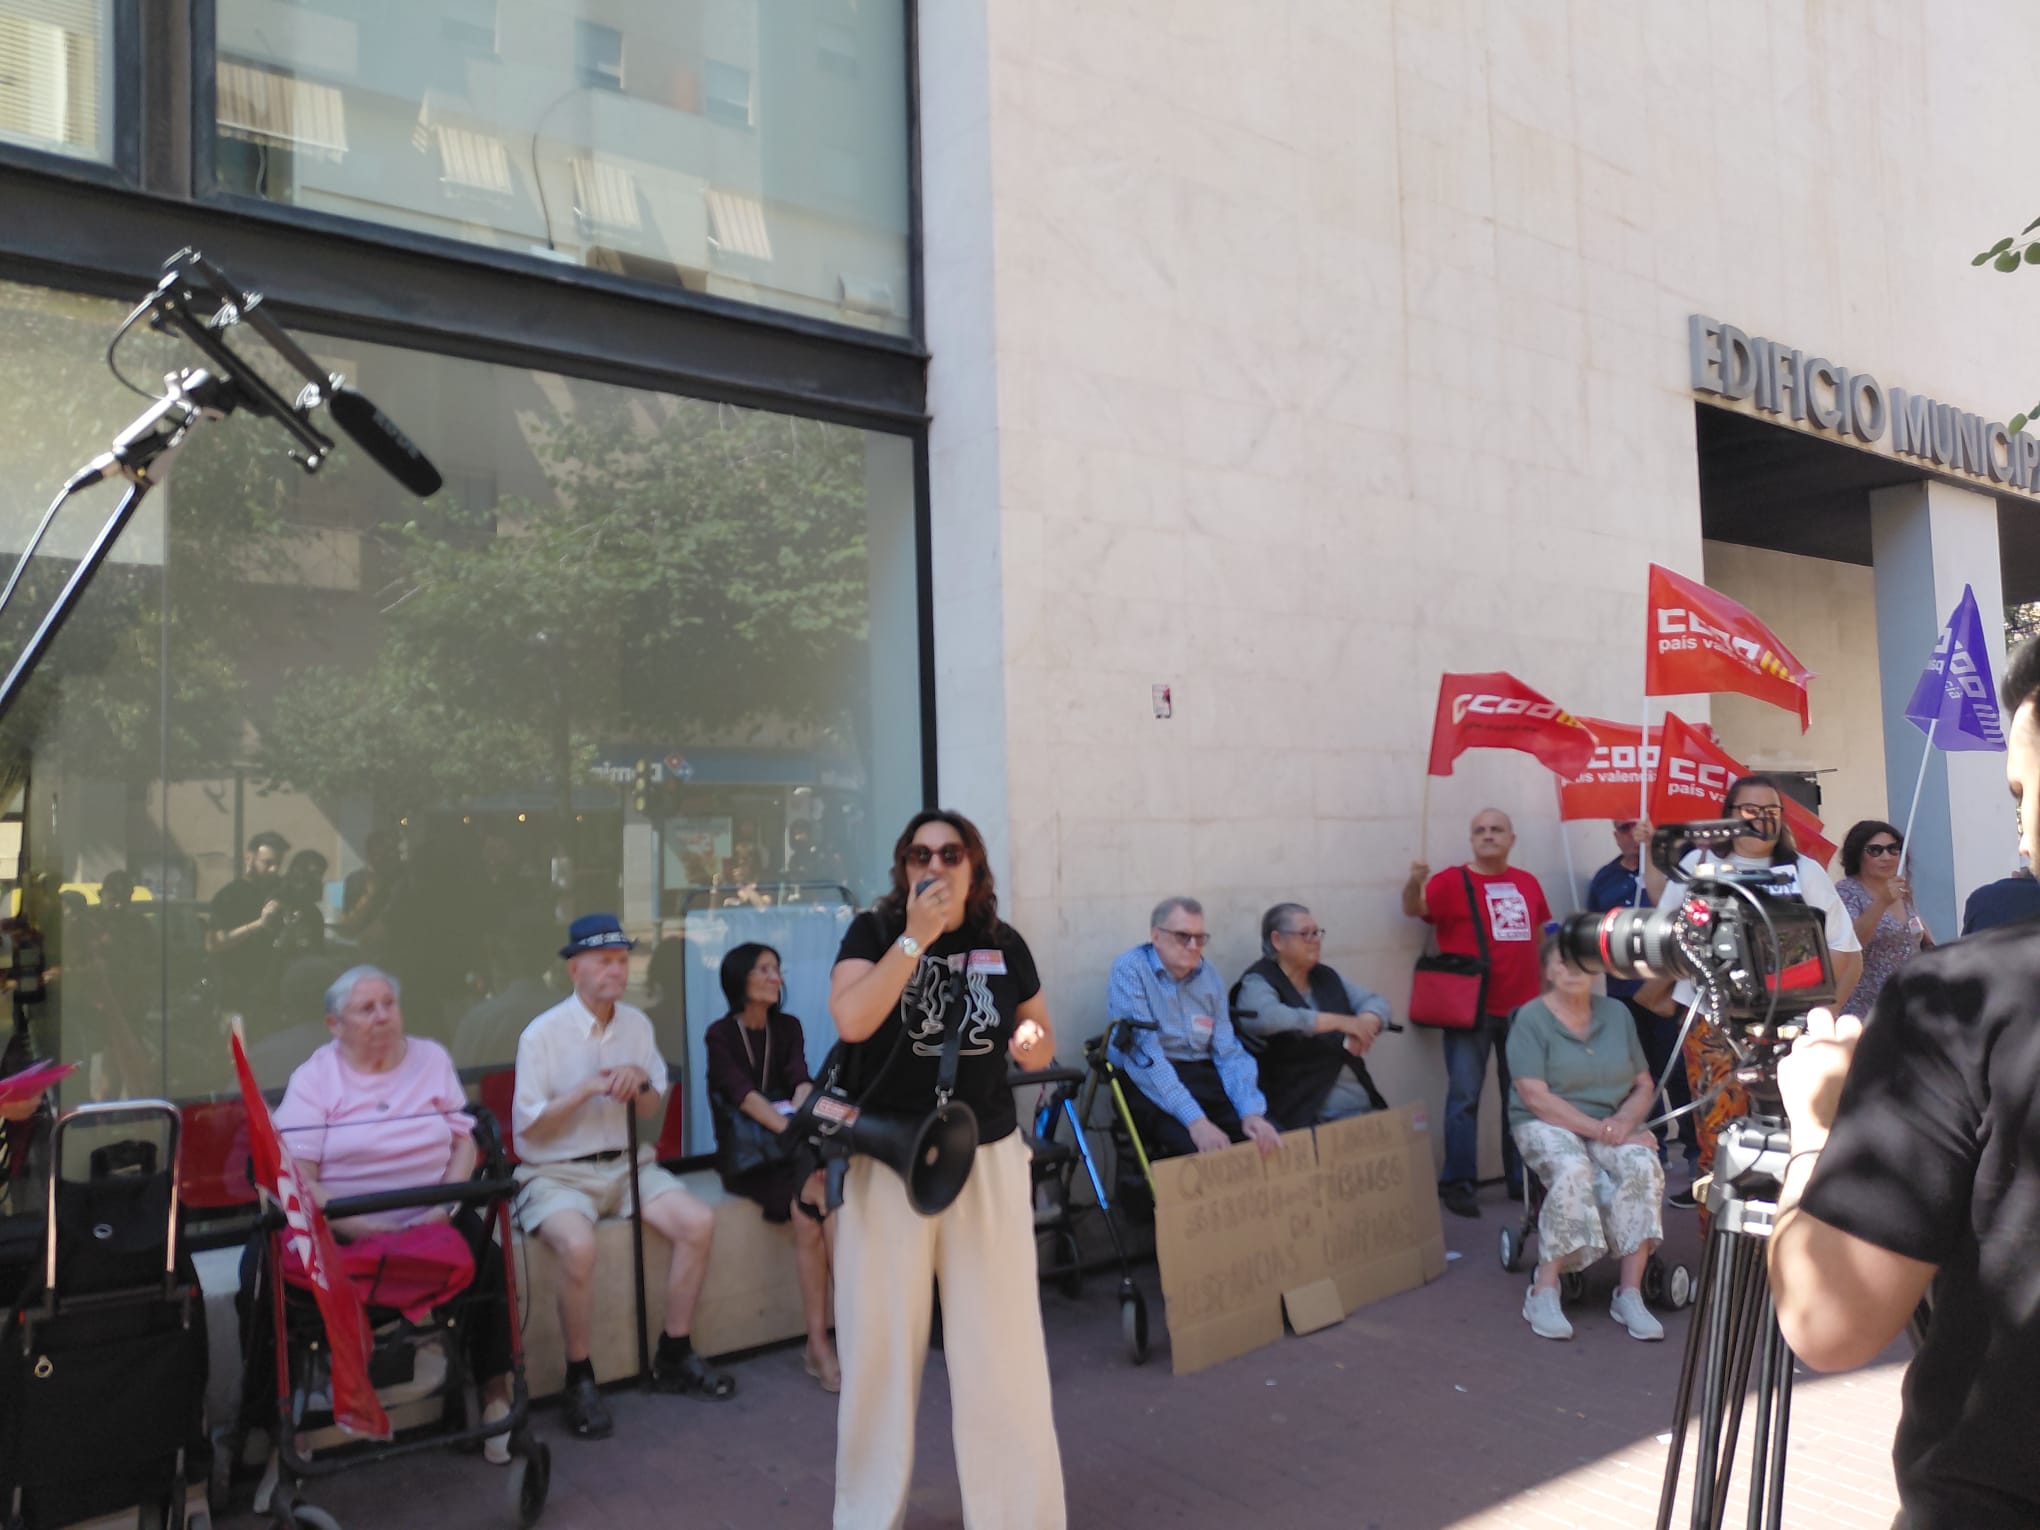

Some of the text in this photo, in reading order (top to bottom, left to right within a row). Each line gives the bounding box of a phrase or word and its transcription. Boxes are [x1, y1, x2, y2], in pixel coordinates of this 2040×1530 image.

[1688, 313, 2040, 494] EDIFICIO MUNICIP
[1658, 635, 1698, 654] país
[1452, 693, 1560, 725] CCOO
[1669, 756, 1739, 791] CC
